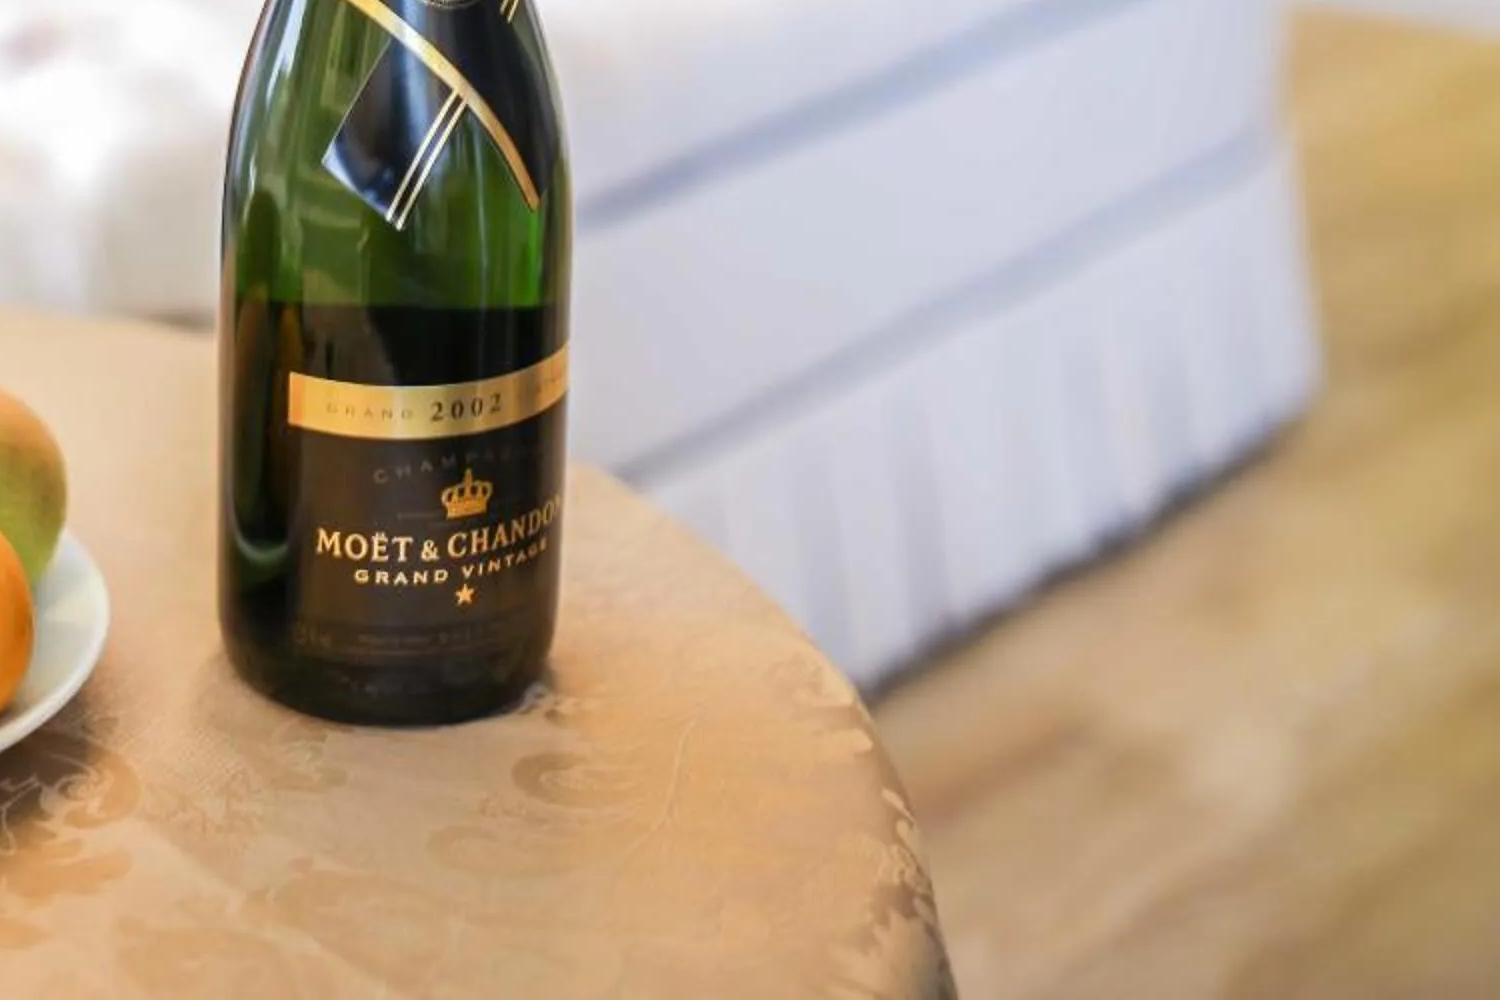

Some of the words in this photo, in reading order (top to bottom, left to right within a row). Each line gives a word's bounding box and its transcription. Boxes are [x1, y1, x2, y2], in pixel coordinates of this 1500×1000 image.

[430, 393, 502, 422] 2002
[316, 527, 414, 562] MOËT
[421, 539, 440, 562] &
[354, 569, 449, 586] GRAND
[461, 537, 548, 579] VINTAGE
